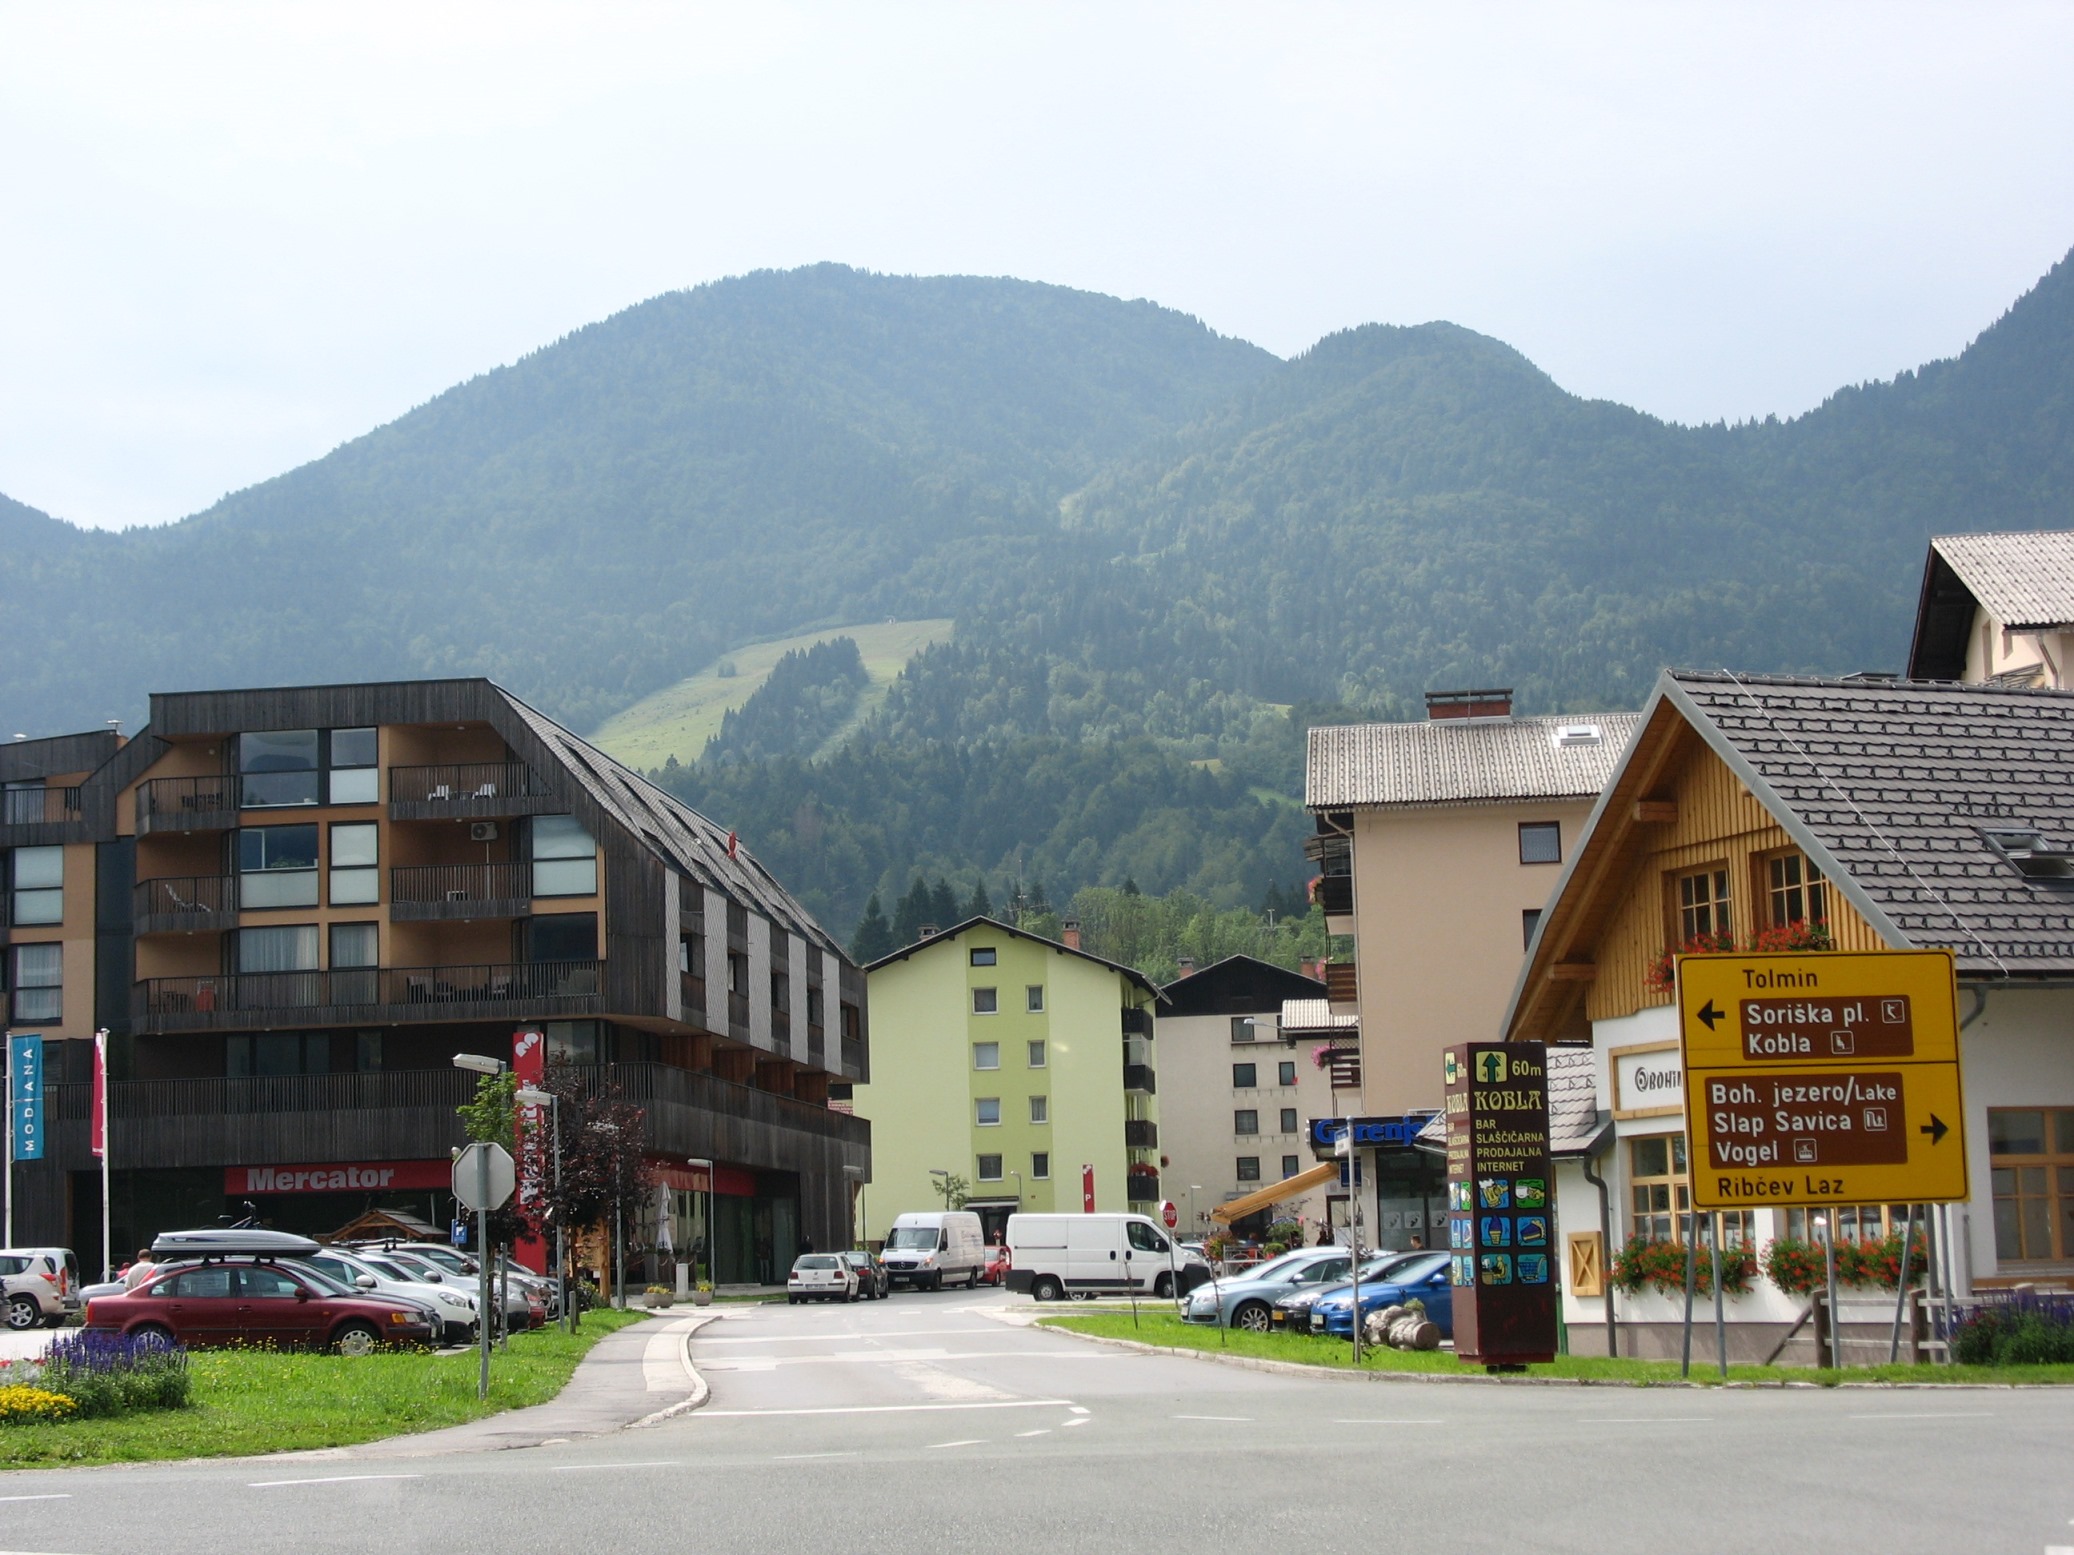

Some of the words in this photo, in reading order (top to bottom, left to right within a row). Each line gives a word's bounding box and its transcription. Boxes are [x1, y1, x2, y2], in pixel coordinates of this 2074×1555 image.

[1742, 969, 1818, 988] Tolmin
[1747, 1003, 1833, 1025] Soriška
[1843, 1002, 1870, 1027] pl.
[1748, 1033, 1811, 1054] Kobla
[1512, 1060, 1542, 1077] 60m
[23, 1048, 35, 1151] MODIANA
[1474, 1090, 1543, 1111] KOBLA
[1711, 1083, 1762, 1105] Boh.
[1773, 1076, 1897, 1107] jezero/Lake
[1475, 1119, 1497, 1130] BAR
[1714, 1112, 1765, 1137] Slap
[1775, 1110, 1852, 1132] Savica
[1476, 1130, 1545, 1144] SLAŠČIČARNA
[1477, 1147, 1543, 1158] PRODAJALNA
[1716, 1140, 1779, 1167] Vogel
[1477, 1161, 1525, 1172] INTERNET
[247, 1166, 395, 1191] Mercator
[1718, 1176, 1795, 1198] Ribčev
[1806, 1175, 1845, 1195] Laz
[1163, 1209, 1176, 1221] STOP
